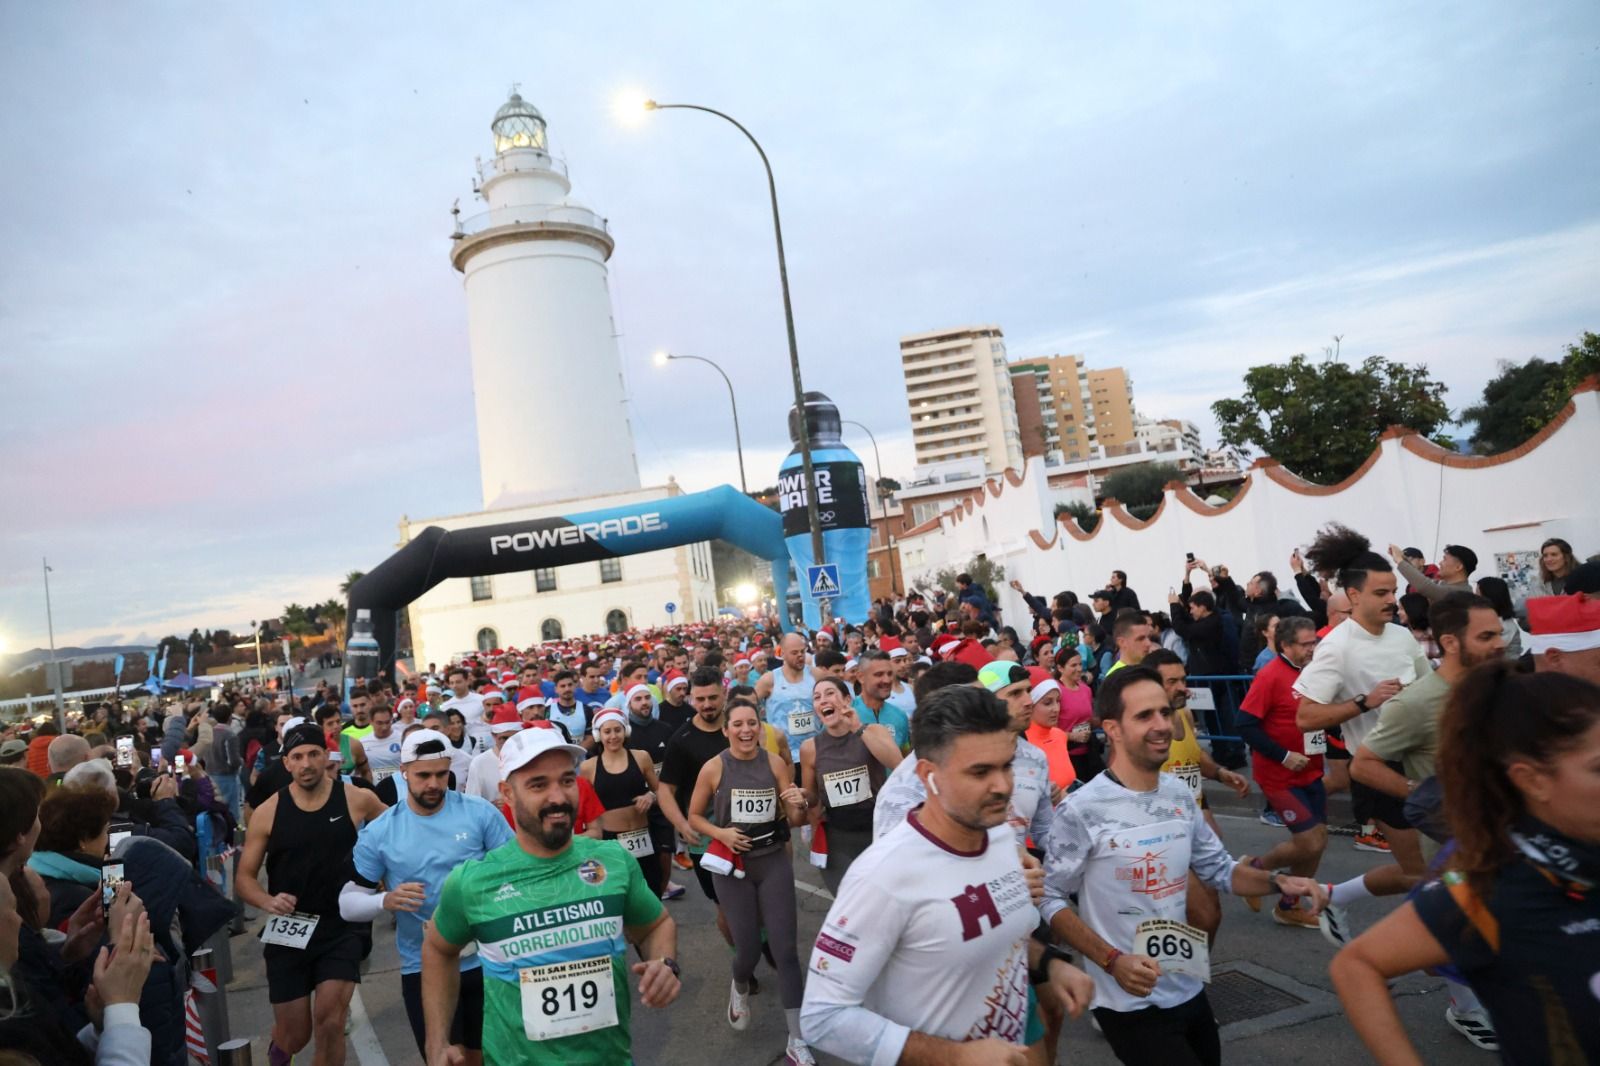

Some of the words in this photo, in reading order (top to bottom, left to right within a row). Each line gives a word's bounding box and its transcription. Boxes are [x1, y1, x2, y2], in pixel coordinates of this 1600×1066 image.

[490, 512, 662, 556] POWERADE
[794, 717, 811, 728] 504
[835, 777, 860, 796] 107
[1178, 774, 1198, 789] 10
[736, 798, 772, 813] 1037
[626, 837, 647, 851] 311
[513, 900, 605, 933] ATLETISMO
[270, 917, 309, 938] 1354
[500, 920, 617, 958] TORREMOLINOS
[1146, 933, 1193, 960] 669
[547, 965, 566, 974] SAN
[541, 980, 598, 1016] 819
